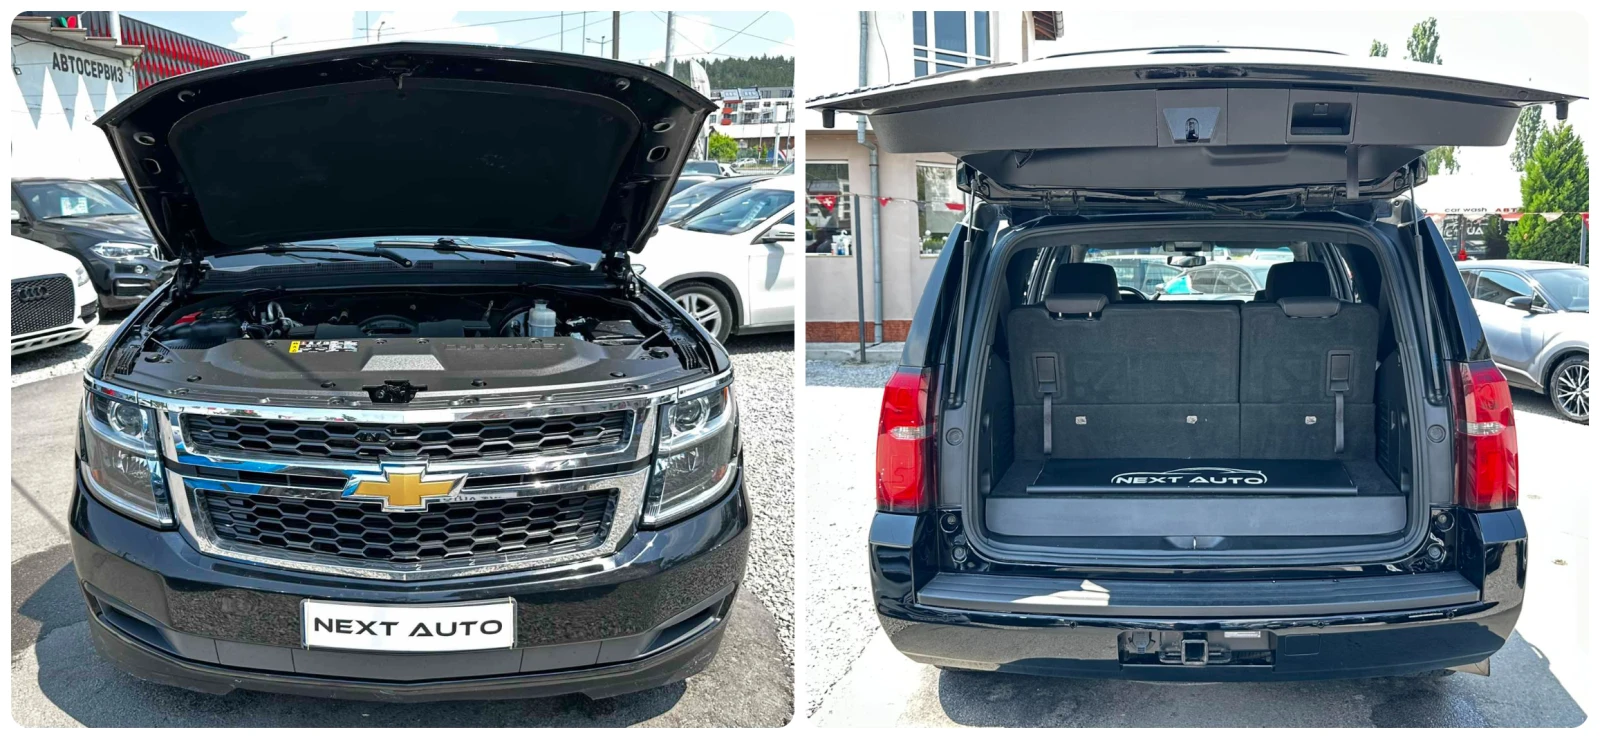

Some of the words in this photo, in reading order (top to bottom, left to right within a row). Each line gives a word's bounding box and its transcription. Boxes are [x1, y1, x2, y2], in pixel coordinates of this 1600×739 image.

[52, 51, 124, 83] АВТОСЕРВИЗ
[1115, 476, 1184, 484] NEXT
[1188, 476, 1264, 485] AUTO
[314, 617, 400, 637] NEXT
[408, 619, 503, 637] AUTO
